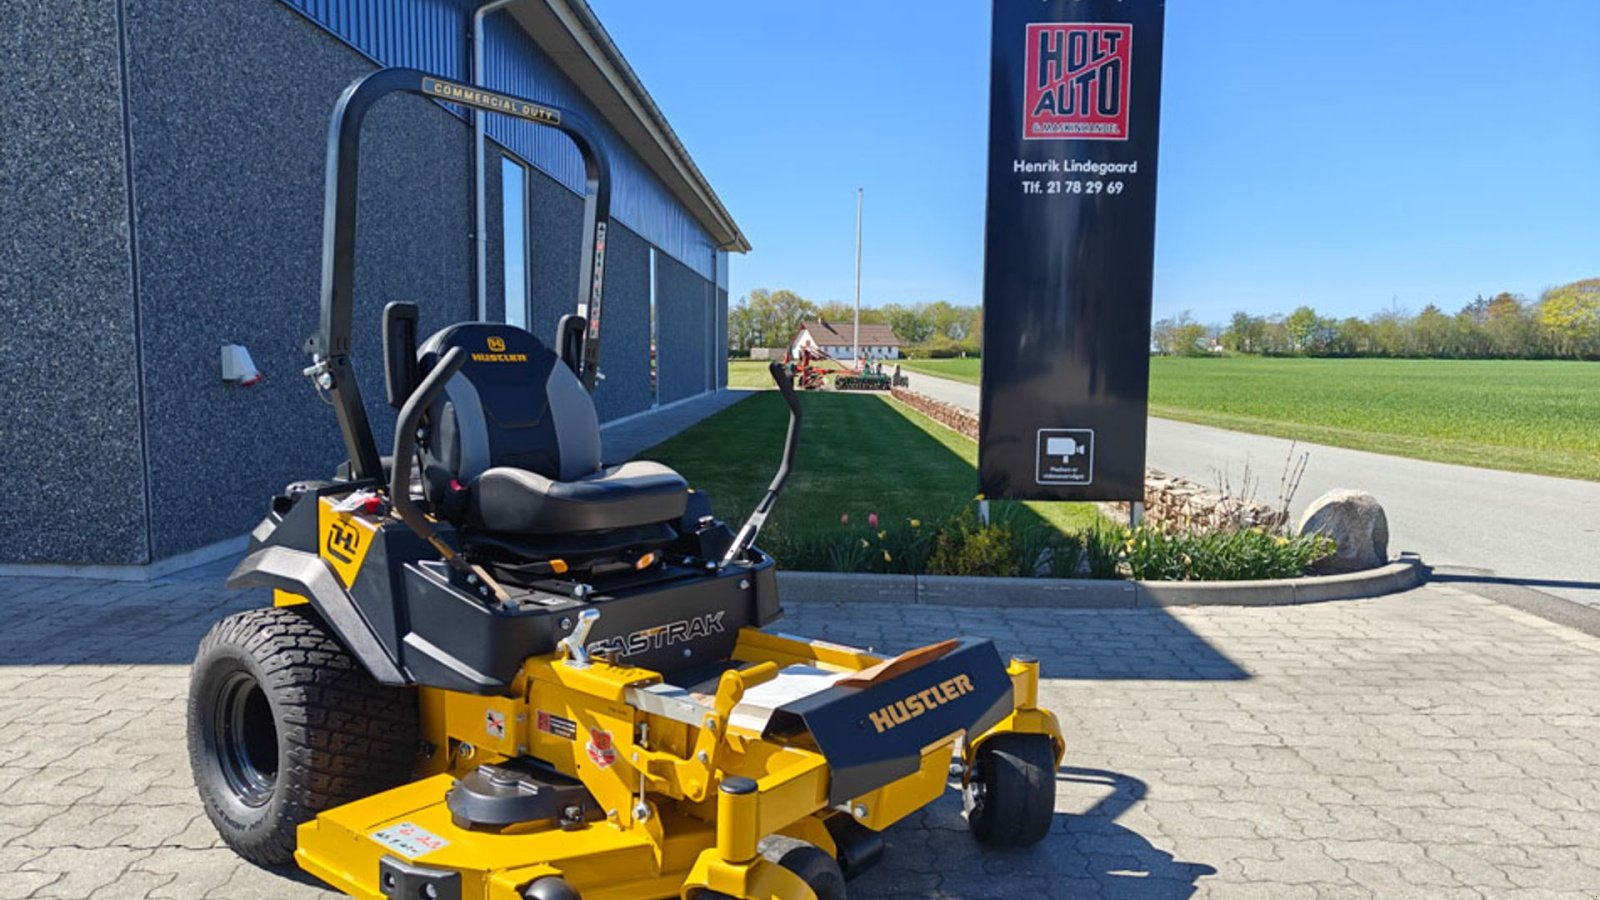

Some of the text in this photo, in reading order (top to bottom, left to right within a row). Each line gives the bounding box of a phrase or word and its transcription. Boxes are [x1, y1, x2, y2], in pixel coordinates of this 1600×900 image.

[1038, 30, 1124, 91] HOLT
[434, 82, 553, 120] COMMERCIAL DUTY
[1031, 56, 1122, 118] AUTO
[1013, 159, 1138, 176] Henrik Lindegaard
[1022, 180, 1124, 195] Tlf. 21 78 29 69
[471, 353, 528, 362] HUSTLER
[868, 673, 975, 734] HUSTLER
